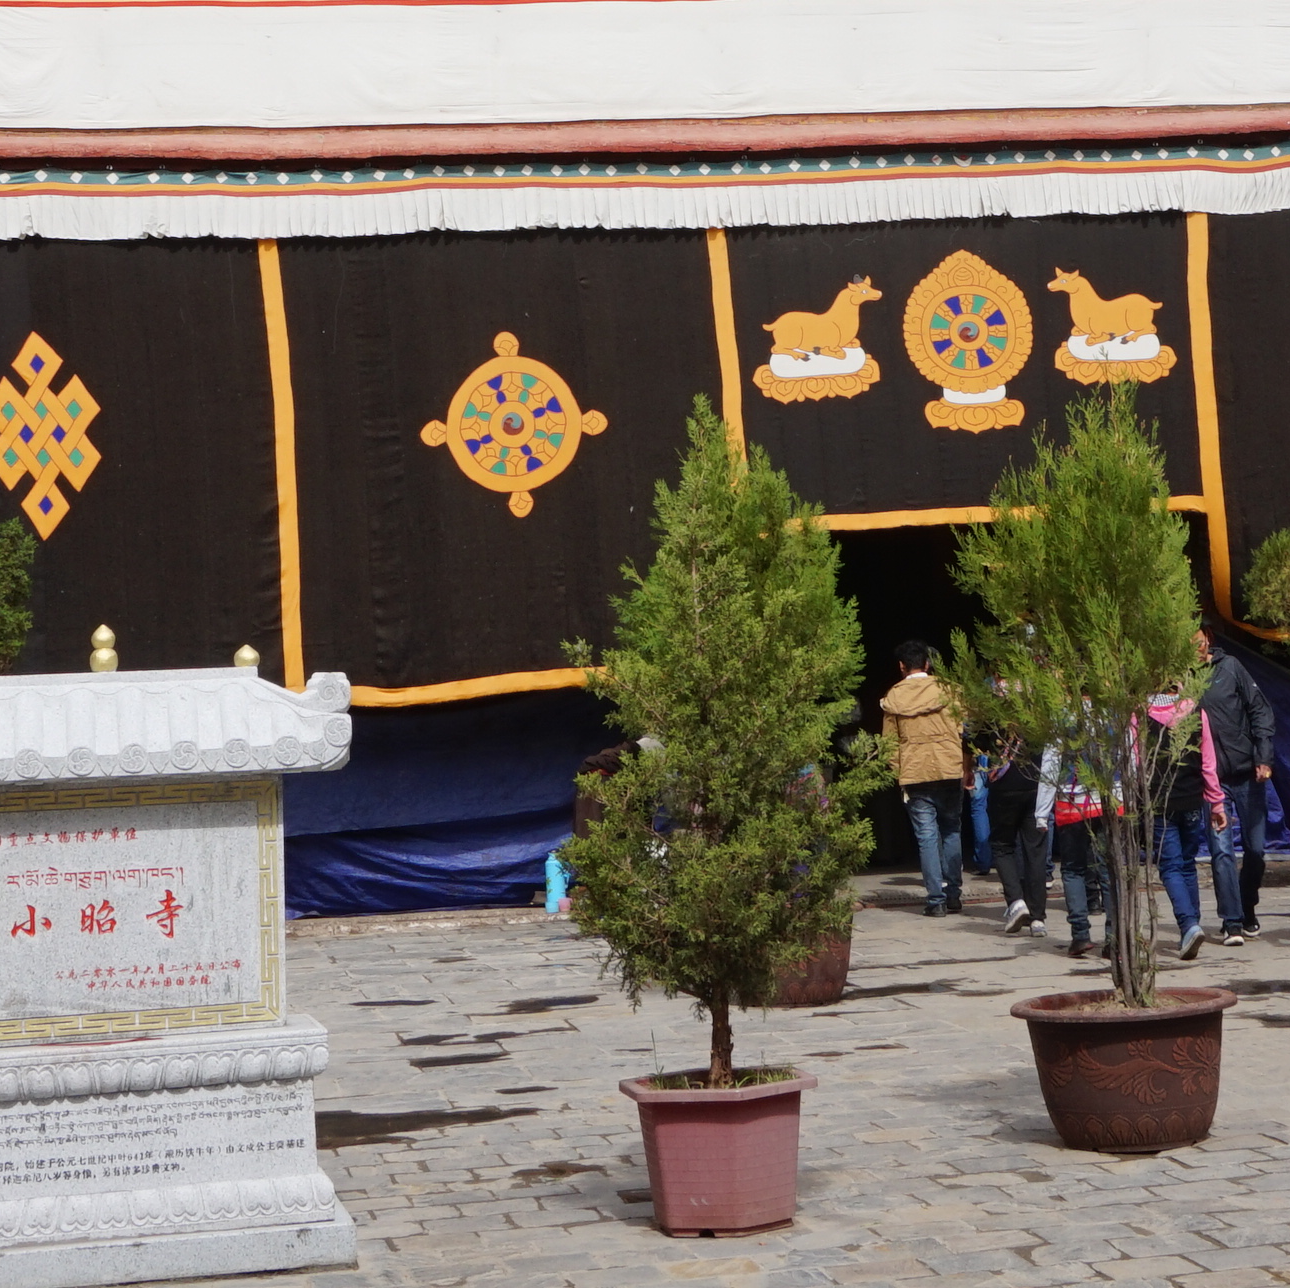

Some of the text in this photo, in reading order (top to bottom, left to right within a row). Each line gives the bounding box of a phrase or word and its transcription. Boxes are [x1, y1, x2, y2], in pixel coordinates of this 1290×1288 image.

[10, 889, 184, 939] 小昭寺
[86, 974, 212, 992] 中华人民共和国国务院
